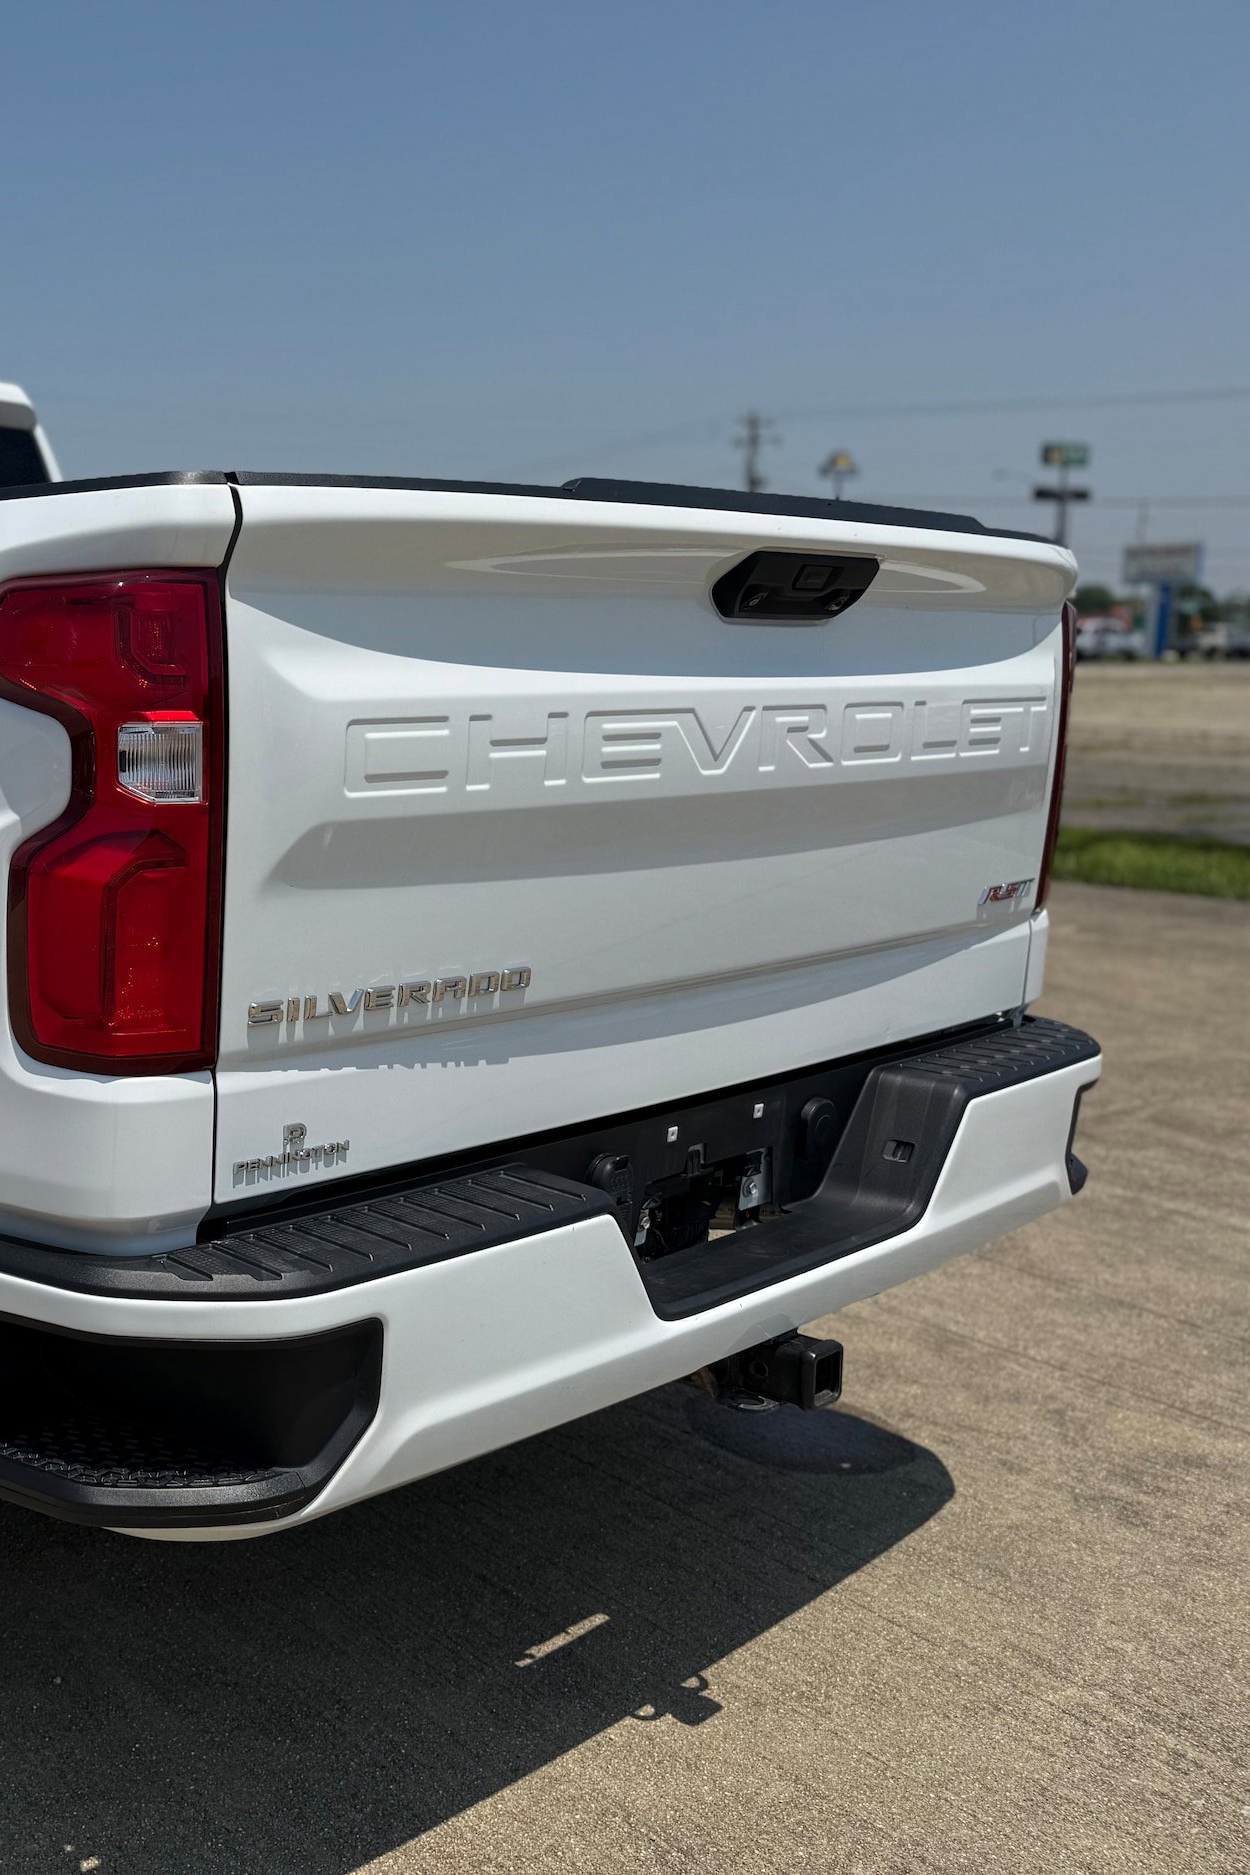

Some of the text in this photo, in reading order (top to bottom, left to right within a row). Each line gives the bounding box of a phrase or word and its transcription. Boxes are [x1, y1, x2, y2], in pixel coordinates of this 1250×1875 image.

[342, 695, 1048, 799] CHEVROLET
[977, 878, 1036, 905] RST
[248, 966, 532, 1027] SILVERADO
[233, 1139, 350, 1176] PENNINGTON
